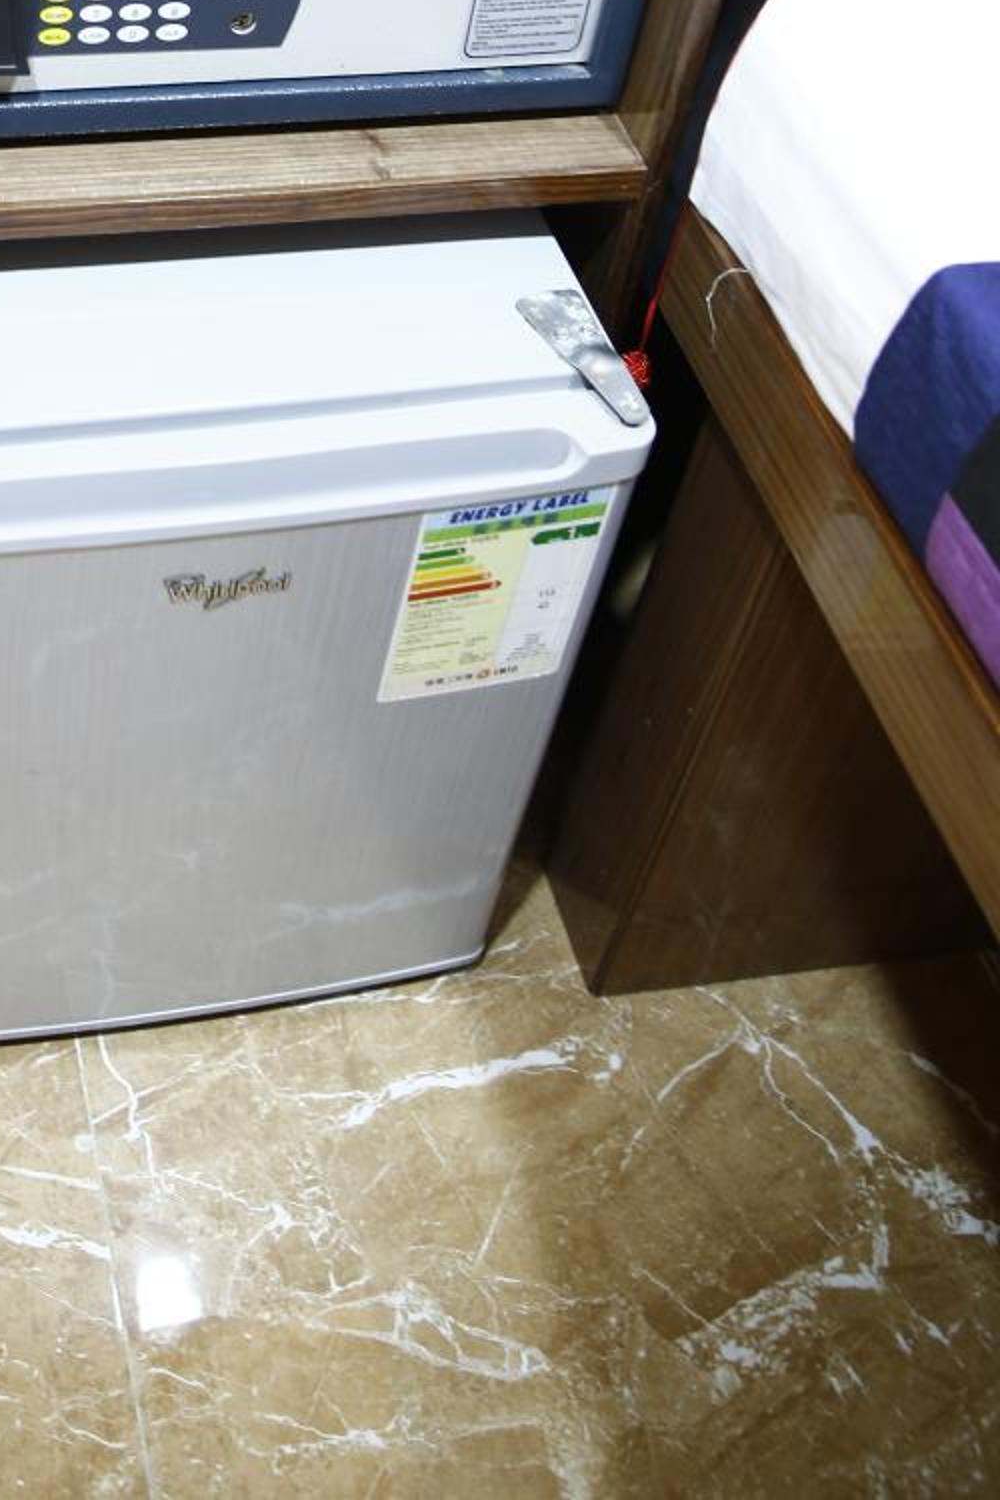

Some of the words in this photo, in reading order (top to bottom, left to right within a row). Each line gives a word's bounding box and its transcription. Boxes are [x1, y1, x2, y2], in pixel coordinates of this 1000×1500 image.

[449, 502, 525, 525] ENERGY
[532, 491, 590, 512] LABEL
[163, 567, 293, 610] Whirlpool
